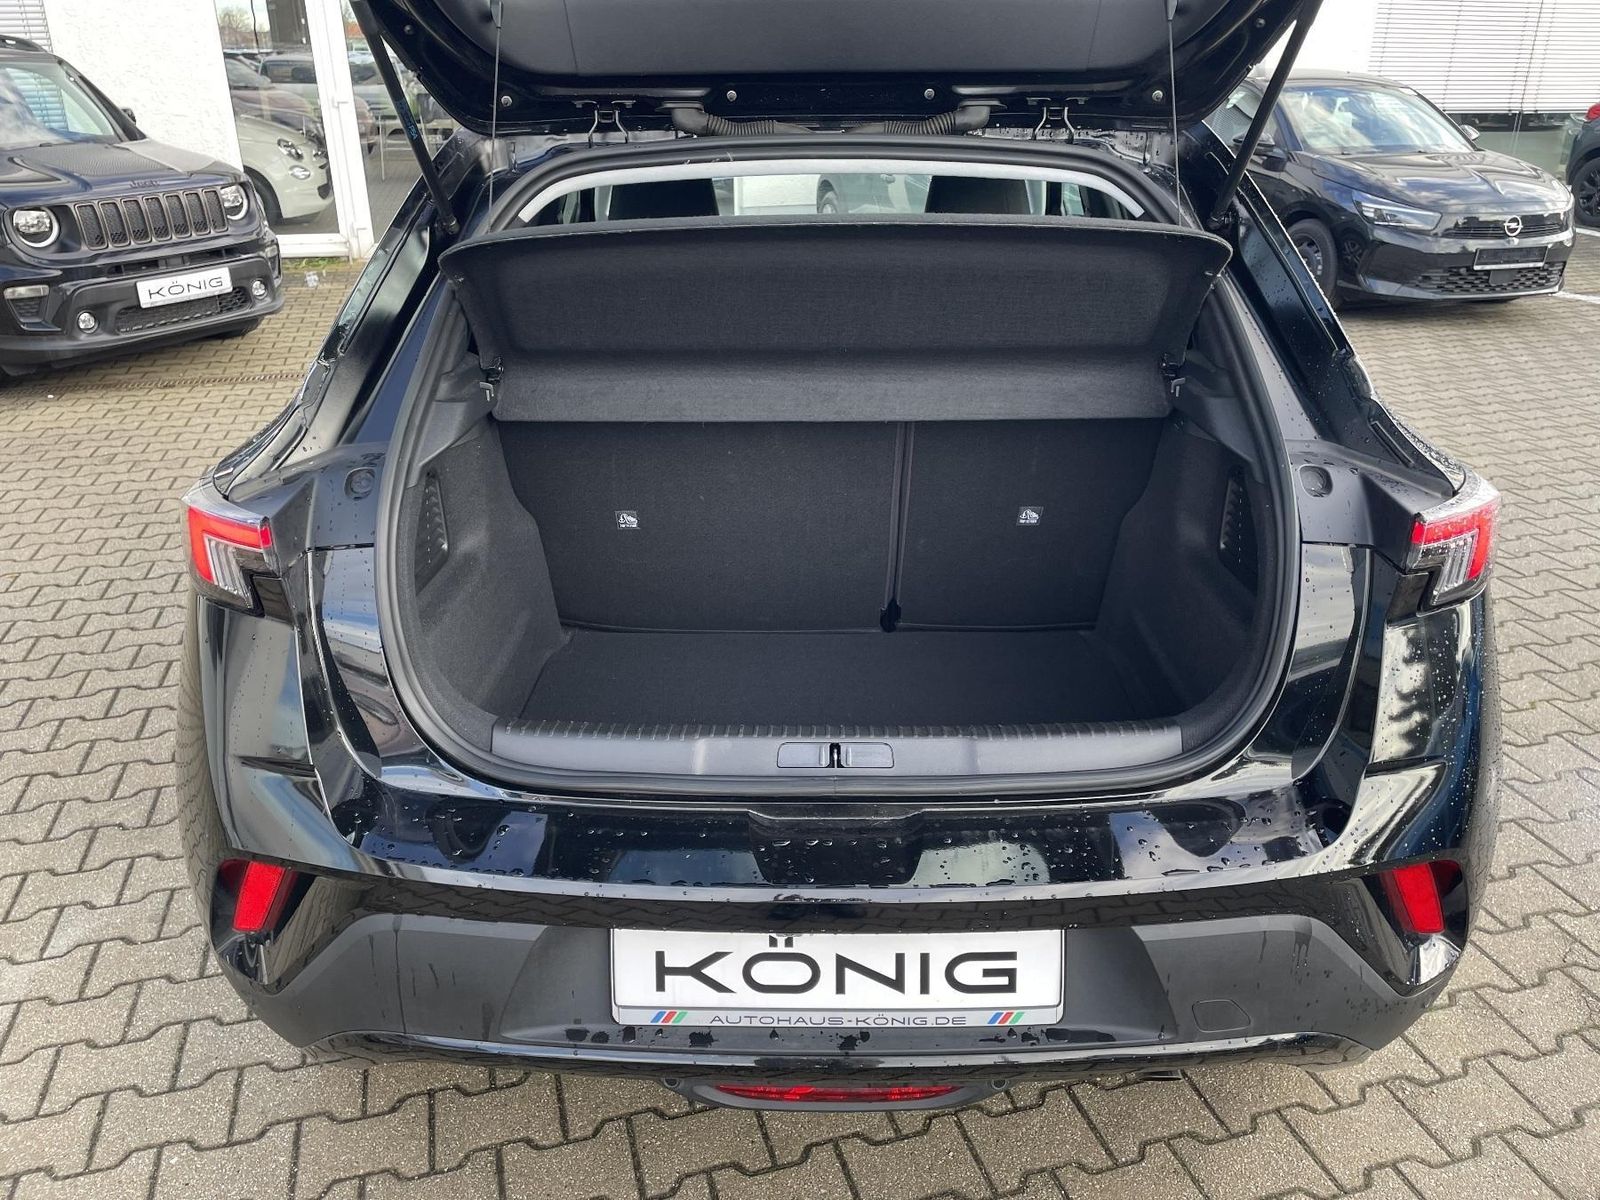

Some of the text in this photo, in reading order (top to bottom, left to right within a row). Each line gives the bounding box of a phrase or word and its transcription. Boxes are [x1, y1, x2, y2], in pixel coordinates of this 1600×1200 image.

[148, 277, 223, 299] KÖNIG
[655, 934, 1018, 995] KÖNIG
[709, 1013, 967, 1026] AUTOHAUS-KÖNIG.DE
